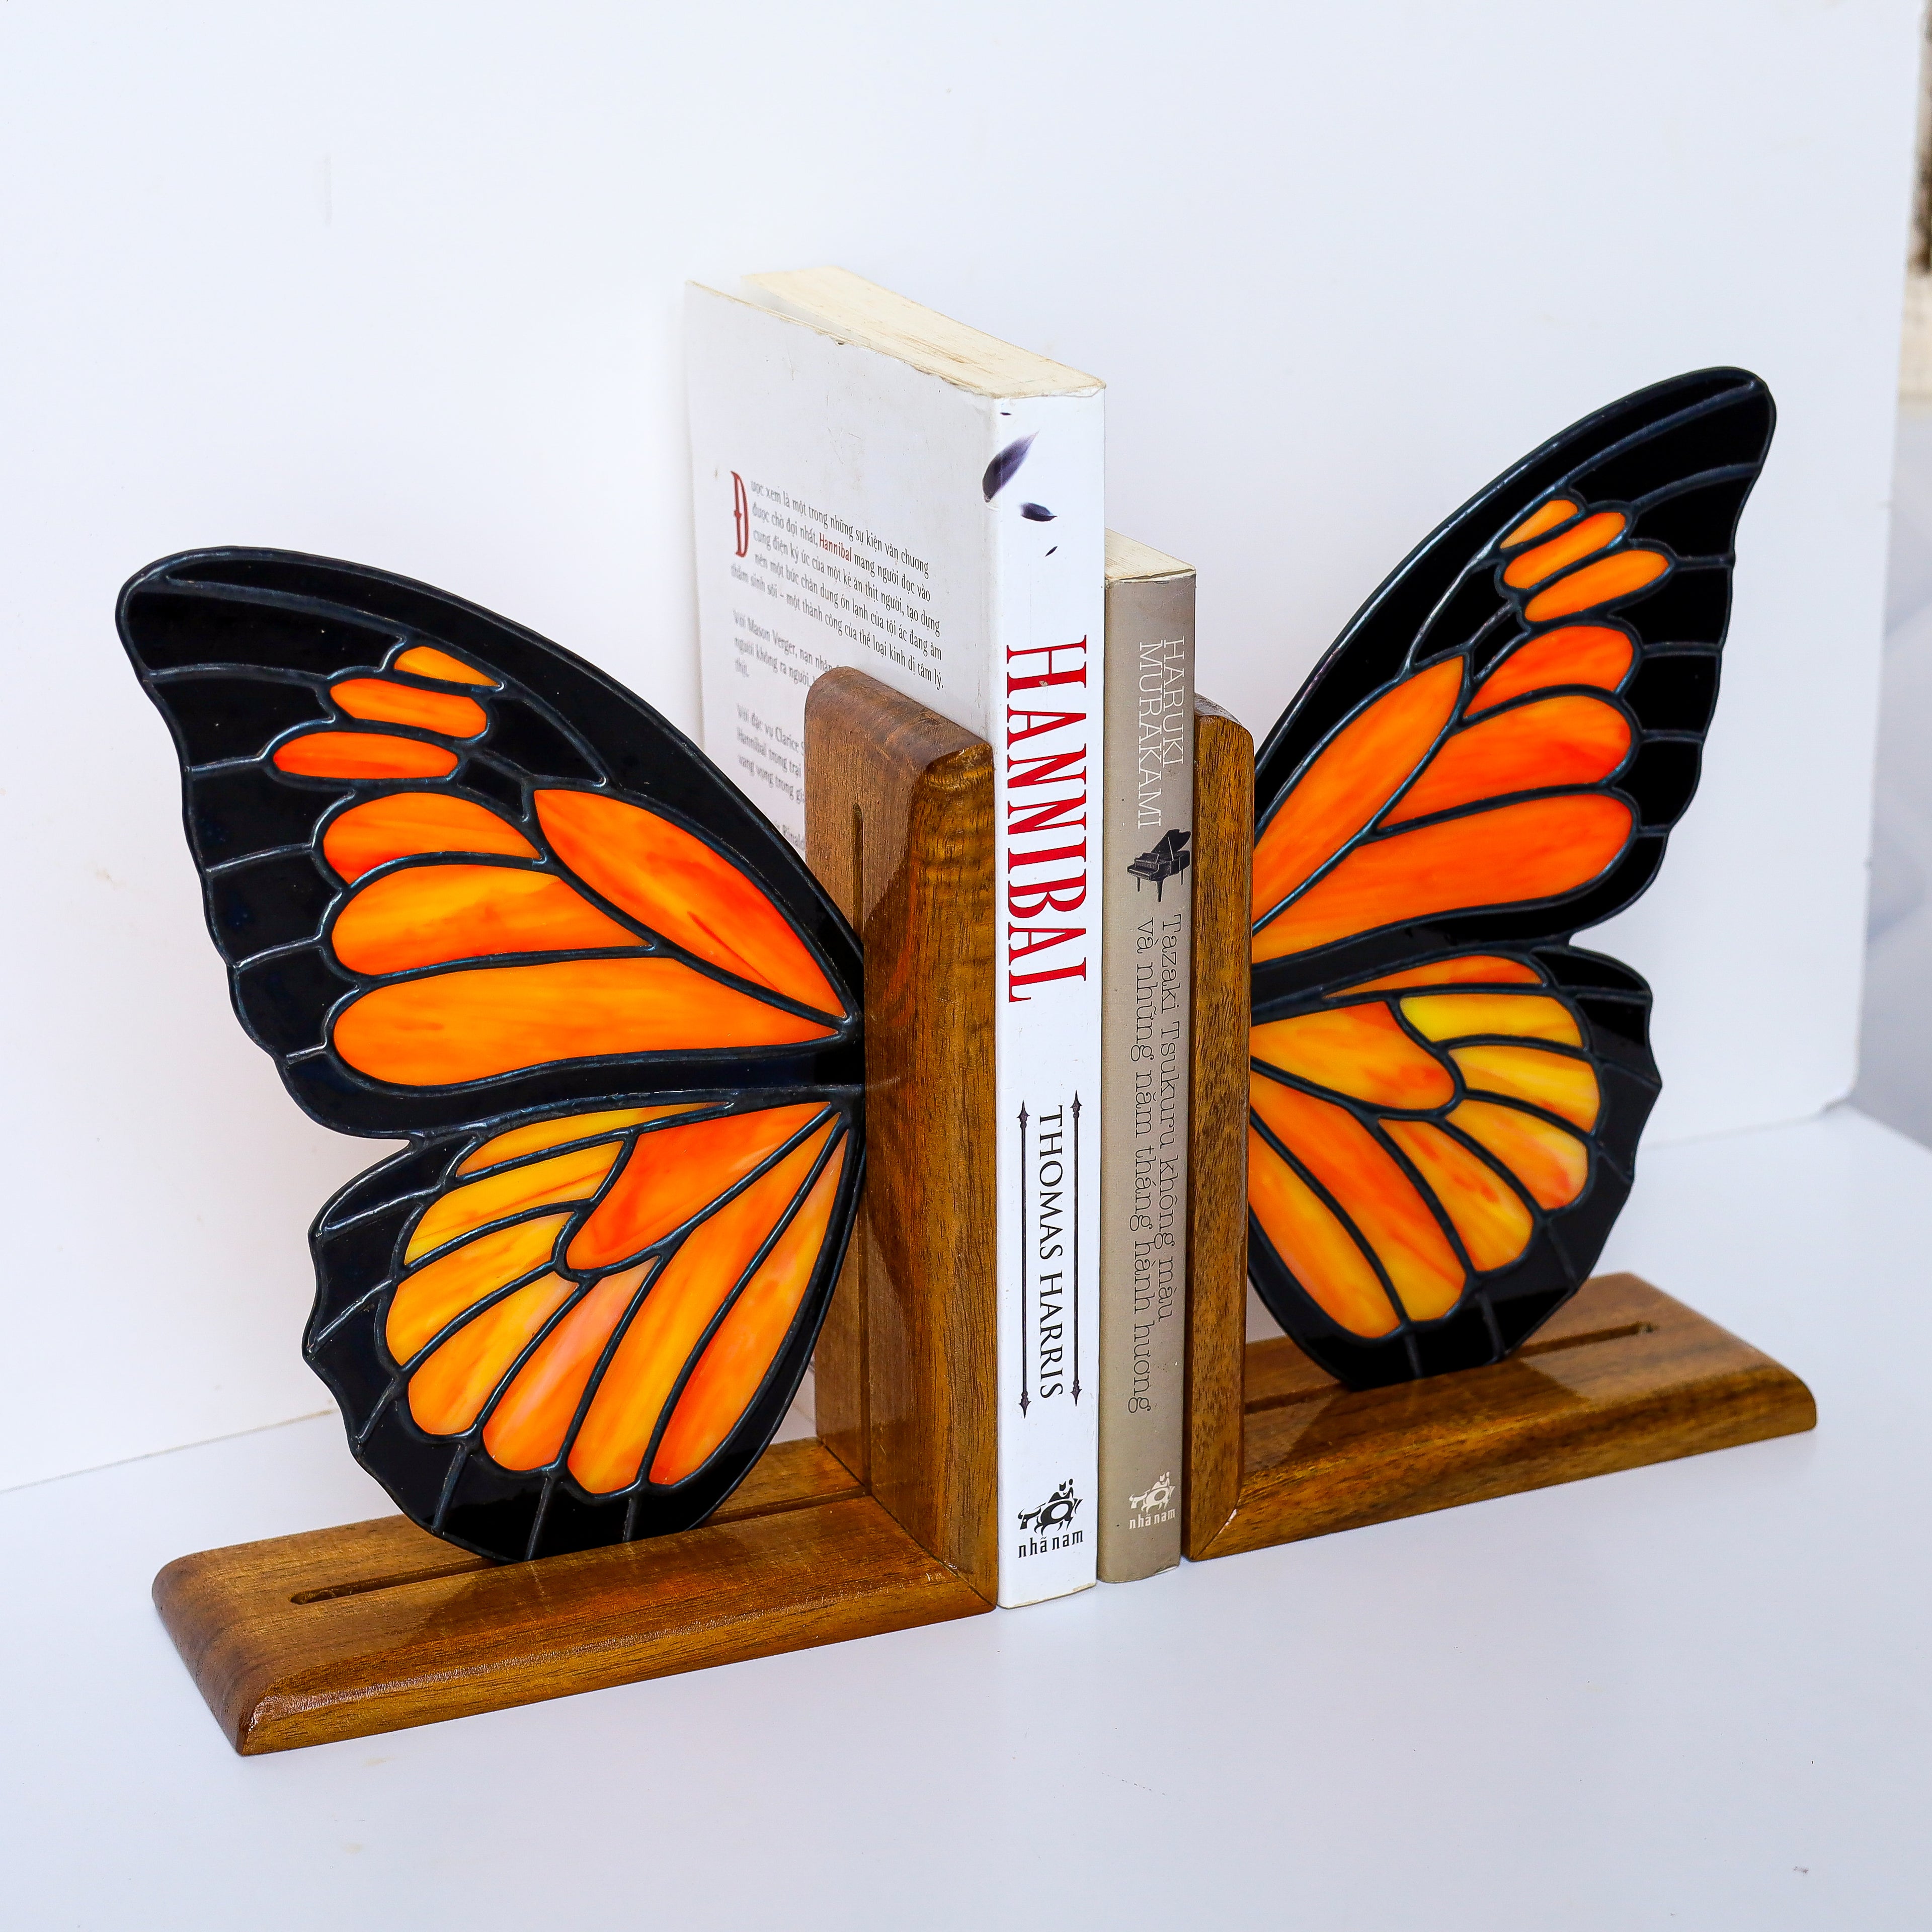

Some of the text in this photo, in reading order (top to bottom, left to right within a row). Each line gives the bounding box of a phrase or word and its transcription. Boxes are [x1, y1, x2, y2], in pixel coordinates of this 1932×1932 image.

[753, 529, 940, 637] cung điện ký ức của một kẻ ăn thịt người, tạo dựng
[765, 488, 781, 504] xem
[783, 491, 790, 508] là
[792, 499, 806, 517] một
[809, 506, 828, 529] trong
[830, 515, 853, 542] những
[856, 529, 864, 546] sự
[866, 530, 882, 552] kiện
[884, 542, 898, 559] văn
[901, 548, 929, 579] chương
[771, 511, 784, 529] chờ
[786, 518, 798, 537] đợi
[800, 525, 818, 548] nhất,
[819, 532, 852, 562] Hannibal
[854, 553, 875, 578] mang
[877, 565, 898, 586] người
[901, 573, 915, 595] đọc
[917, 584, 930, 602] vào
[770, 562, 784, 578] một
[786, 565, 799, 585] bức
[801, 574, 818, 594] chân
[820, 583, 839, 609] dung
[841, 594, 850, 611] ớn
[852, 598, 868, 621] lạnh
[870, 611, 884, 629] của
[887, 618, 896, 636] tội
[899, 624, 907, 642] ác
[909, 629, 928, 657] đang
[930, 642, 942, 661] âm
[786, 594, 800, 611] một
[802, 599, 823, 622] thành
[825, 613, 843, 636] công
[845, 622, 857, 641] của
[859, 629, 870, 648] thể
[873, 635, 887, 658] loại
[889, 643, 906, 667] kinh
[908, 655, 915, 675] dị
[918, 662, 932, 682] tâm
[934, 668, 944, 690] lý.
[800, 649, 813, 665] nạn
[1138, 641, 1162, 829] MURAKAMI
[1162, 635, 1185, 768] HARUKI
[1006, 634, 1087, 1003] HANNIBAL
[1128, 917, 1159, 1413] và những năm tháng hành hương
[1154, 914, 1181, 1323] Tazaki Tsukuru không màu
[1039, 1105, 1063, 1398] THOMAS HARRIS
[1018, 1530, 1083, 1559] nhã nam
[1129, 1508, 1175, 1530] nhã nam
